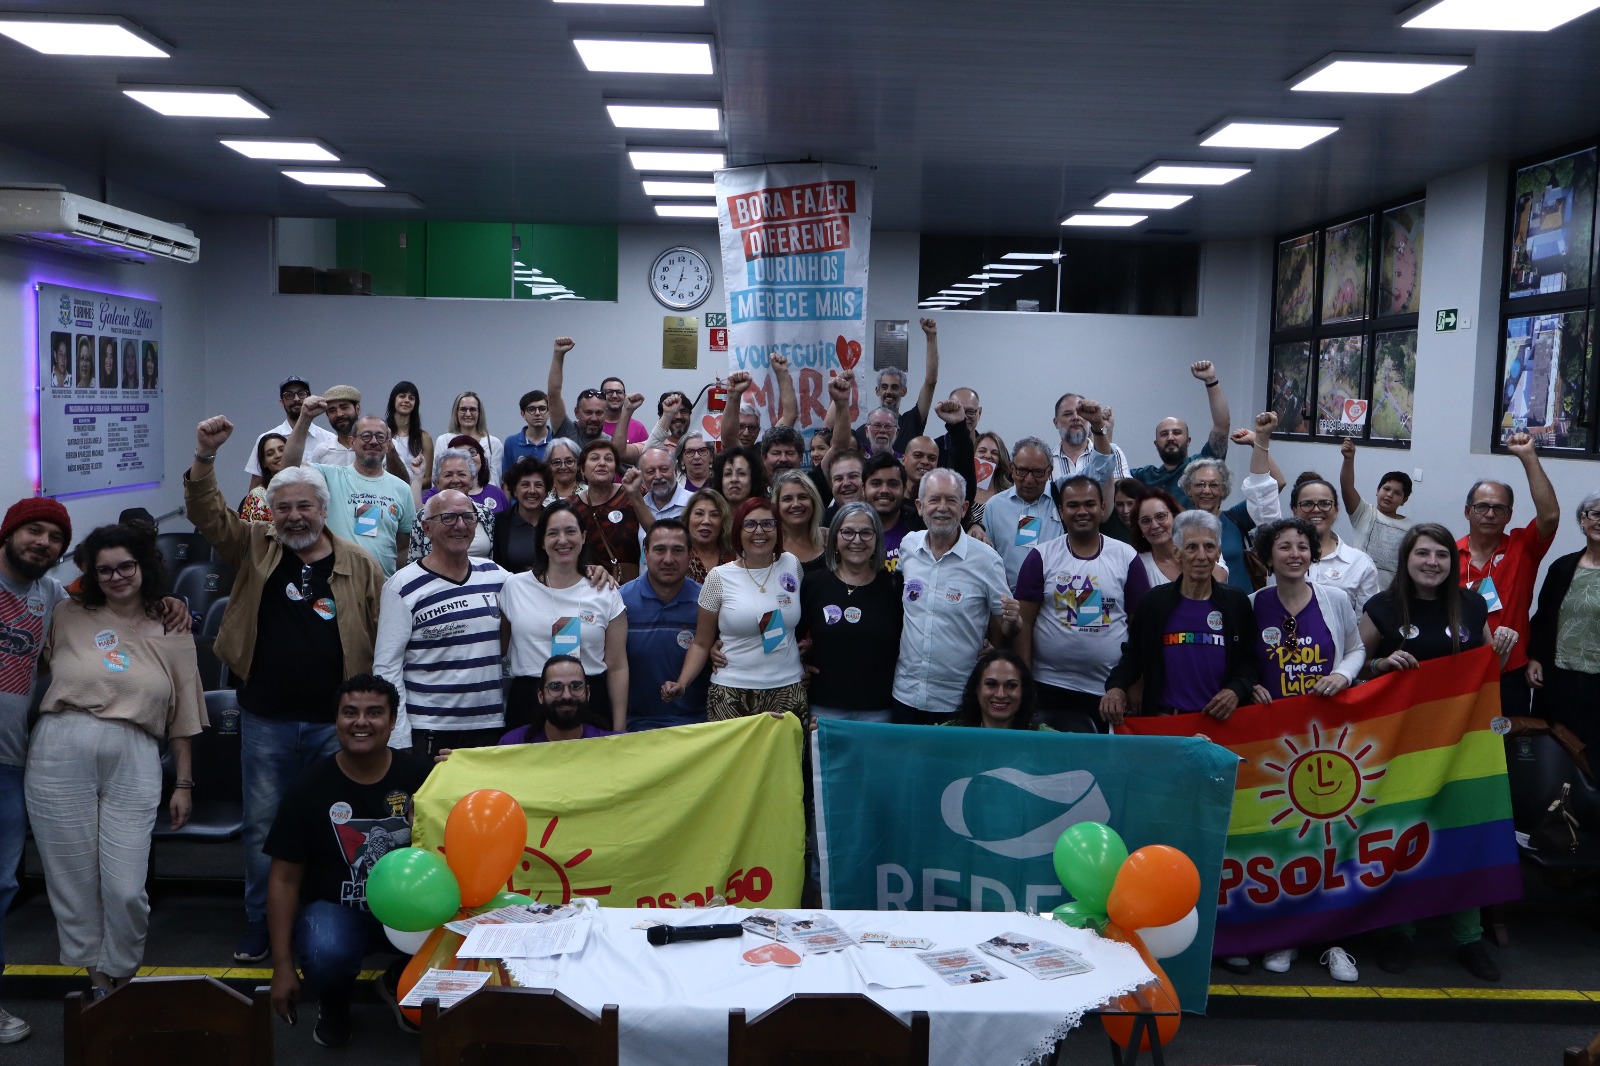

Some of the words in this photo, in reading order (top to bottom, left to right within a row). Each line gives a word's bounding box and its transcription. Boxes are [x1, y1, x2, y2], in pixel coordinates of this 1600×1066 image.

[736, 191, 786, 224] BORA
[791, 184, 848, 215] FAZER
[749, 220, 843, 256] DIFERENTE
[754, 255, 838, 282] OURINHOS
[738, 291, 809, 319] MERECE
[815, 291, 856, 317] MAIS
[736, 343, 771, 370] VOU
[415, 600, 469, 625] AUTHENTIC
[1275, 643, 1329, 670] PSOL
[1284, 664, 1308, 681] que
[1309, 664, 1323, 673] as
[1216, 847, 1346, 906] PSOL
[1358, 821, 1430, 888] 50
[725, 866, 773, 906] 50
